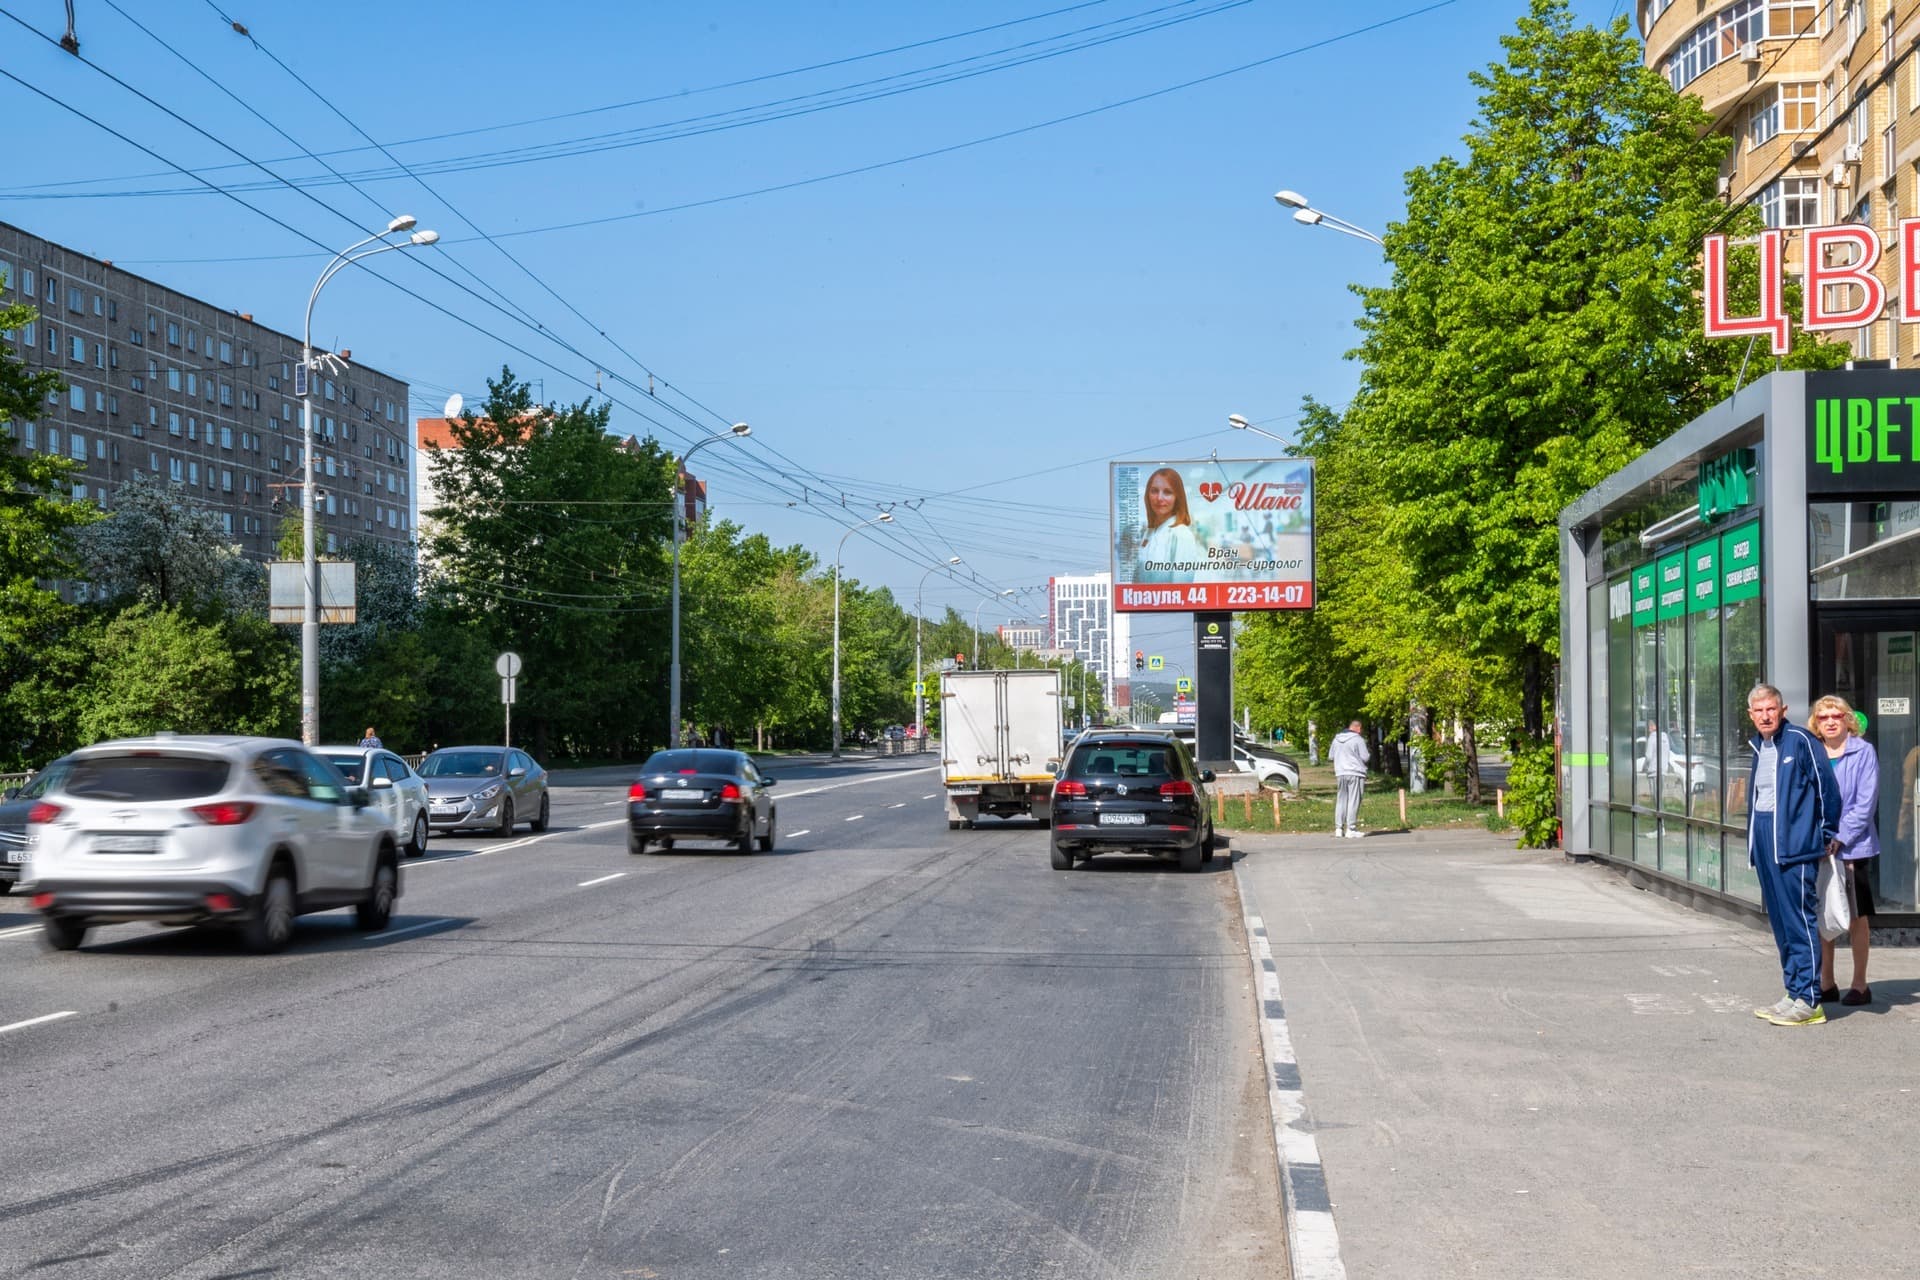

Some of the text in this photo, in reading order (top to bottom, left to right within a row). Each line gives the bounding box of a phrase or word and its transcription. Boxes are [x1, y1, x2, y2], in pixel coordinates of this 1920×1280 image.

[1228, 482, 1303, 511] Шанс
[1207, 547, 1239, 560] Врач
[1122, 587, 1207, 606] Крауля, 44
[1227, 586, 1304, 604] 223-14-07
